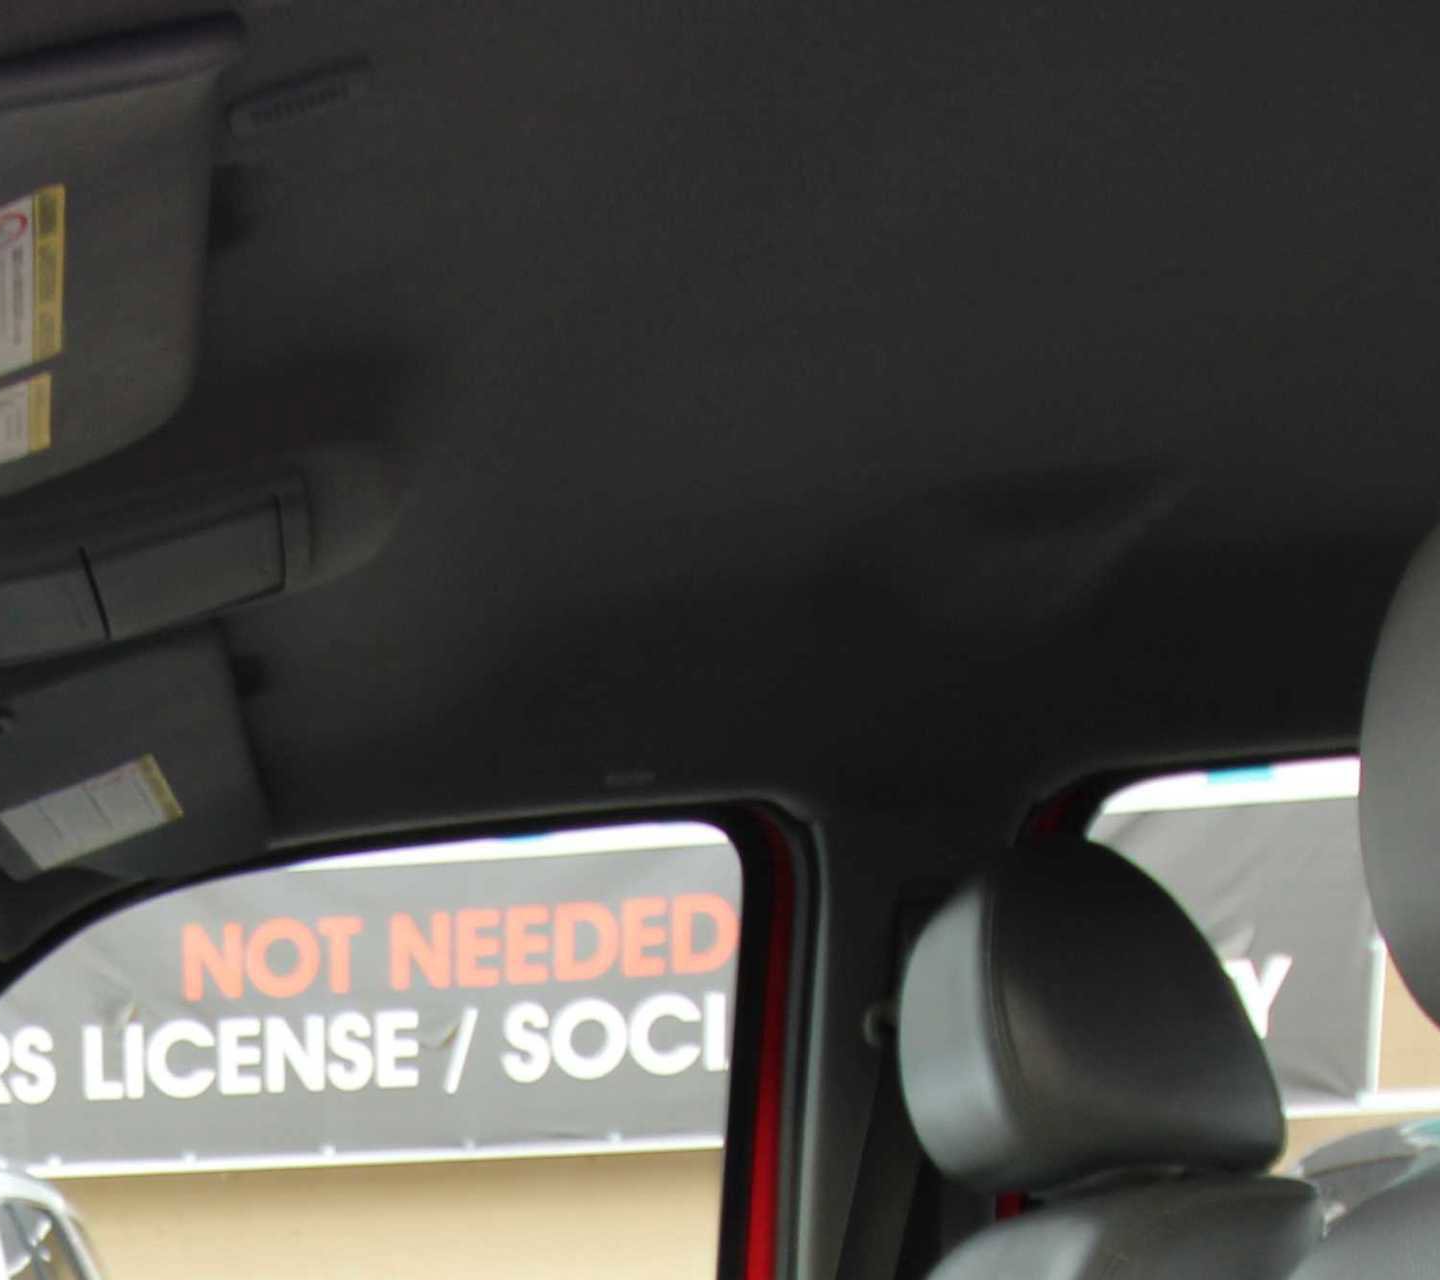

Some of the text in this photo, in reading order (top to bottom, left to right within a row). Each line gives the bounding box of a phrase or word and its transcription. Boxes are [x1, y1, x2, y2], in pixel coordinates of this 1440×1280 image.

[180, 891, 740, 1002] NOT NEEDED
[81, 1007, 421, 1101] LICENSE
[443, 1006, 479, 1095] /
[500, 990, 730, 1084] SOCI
